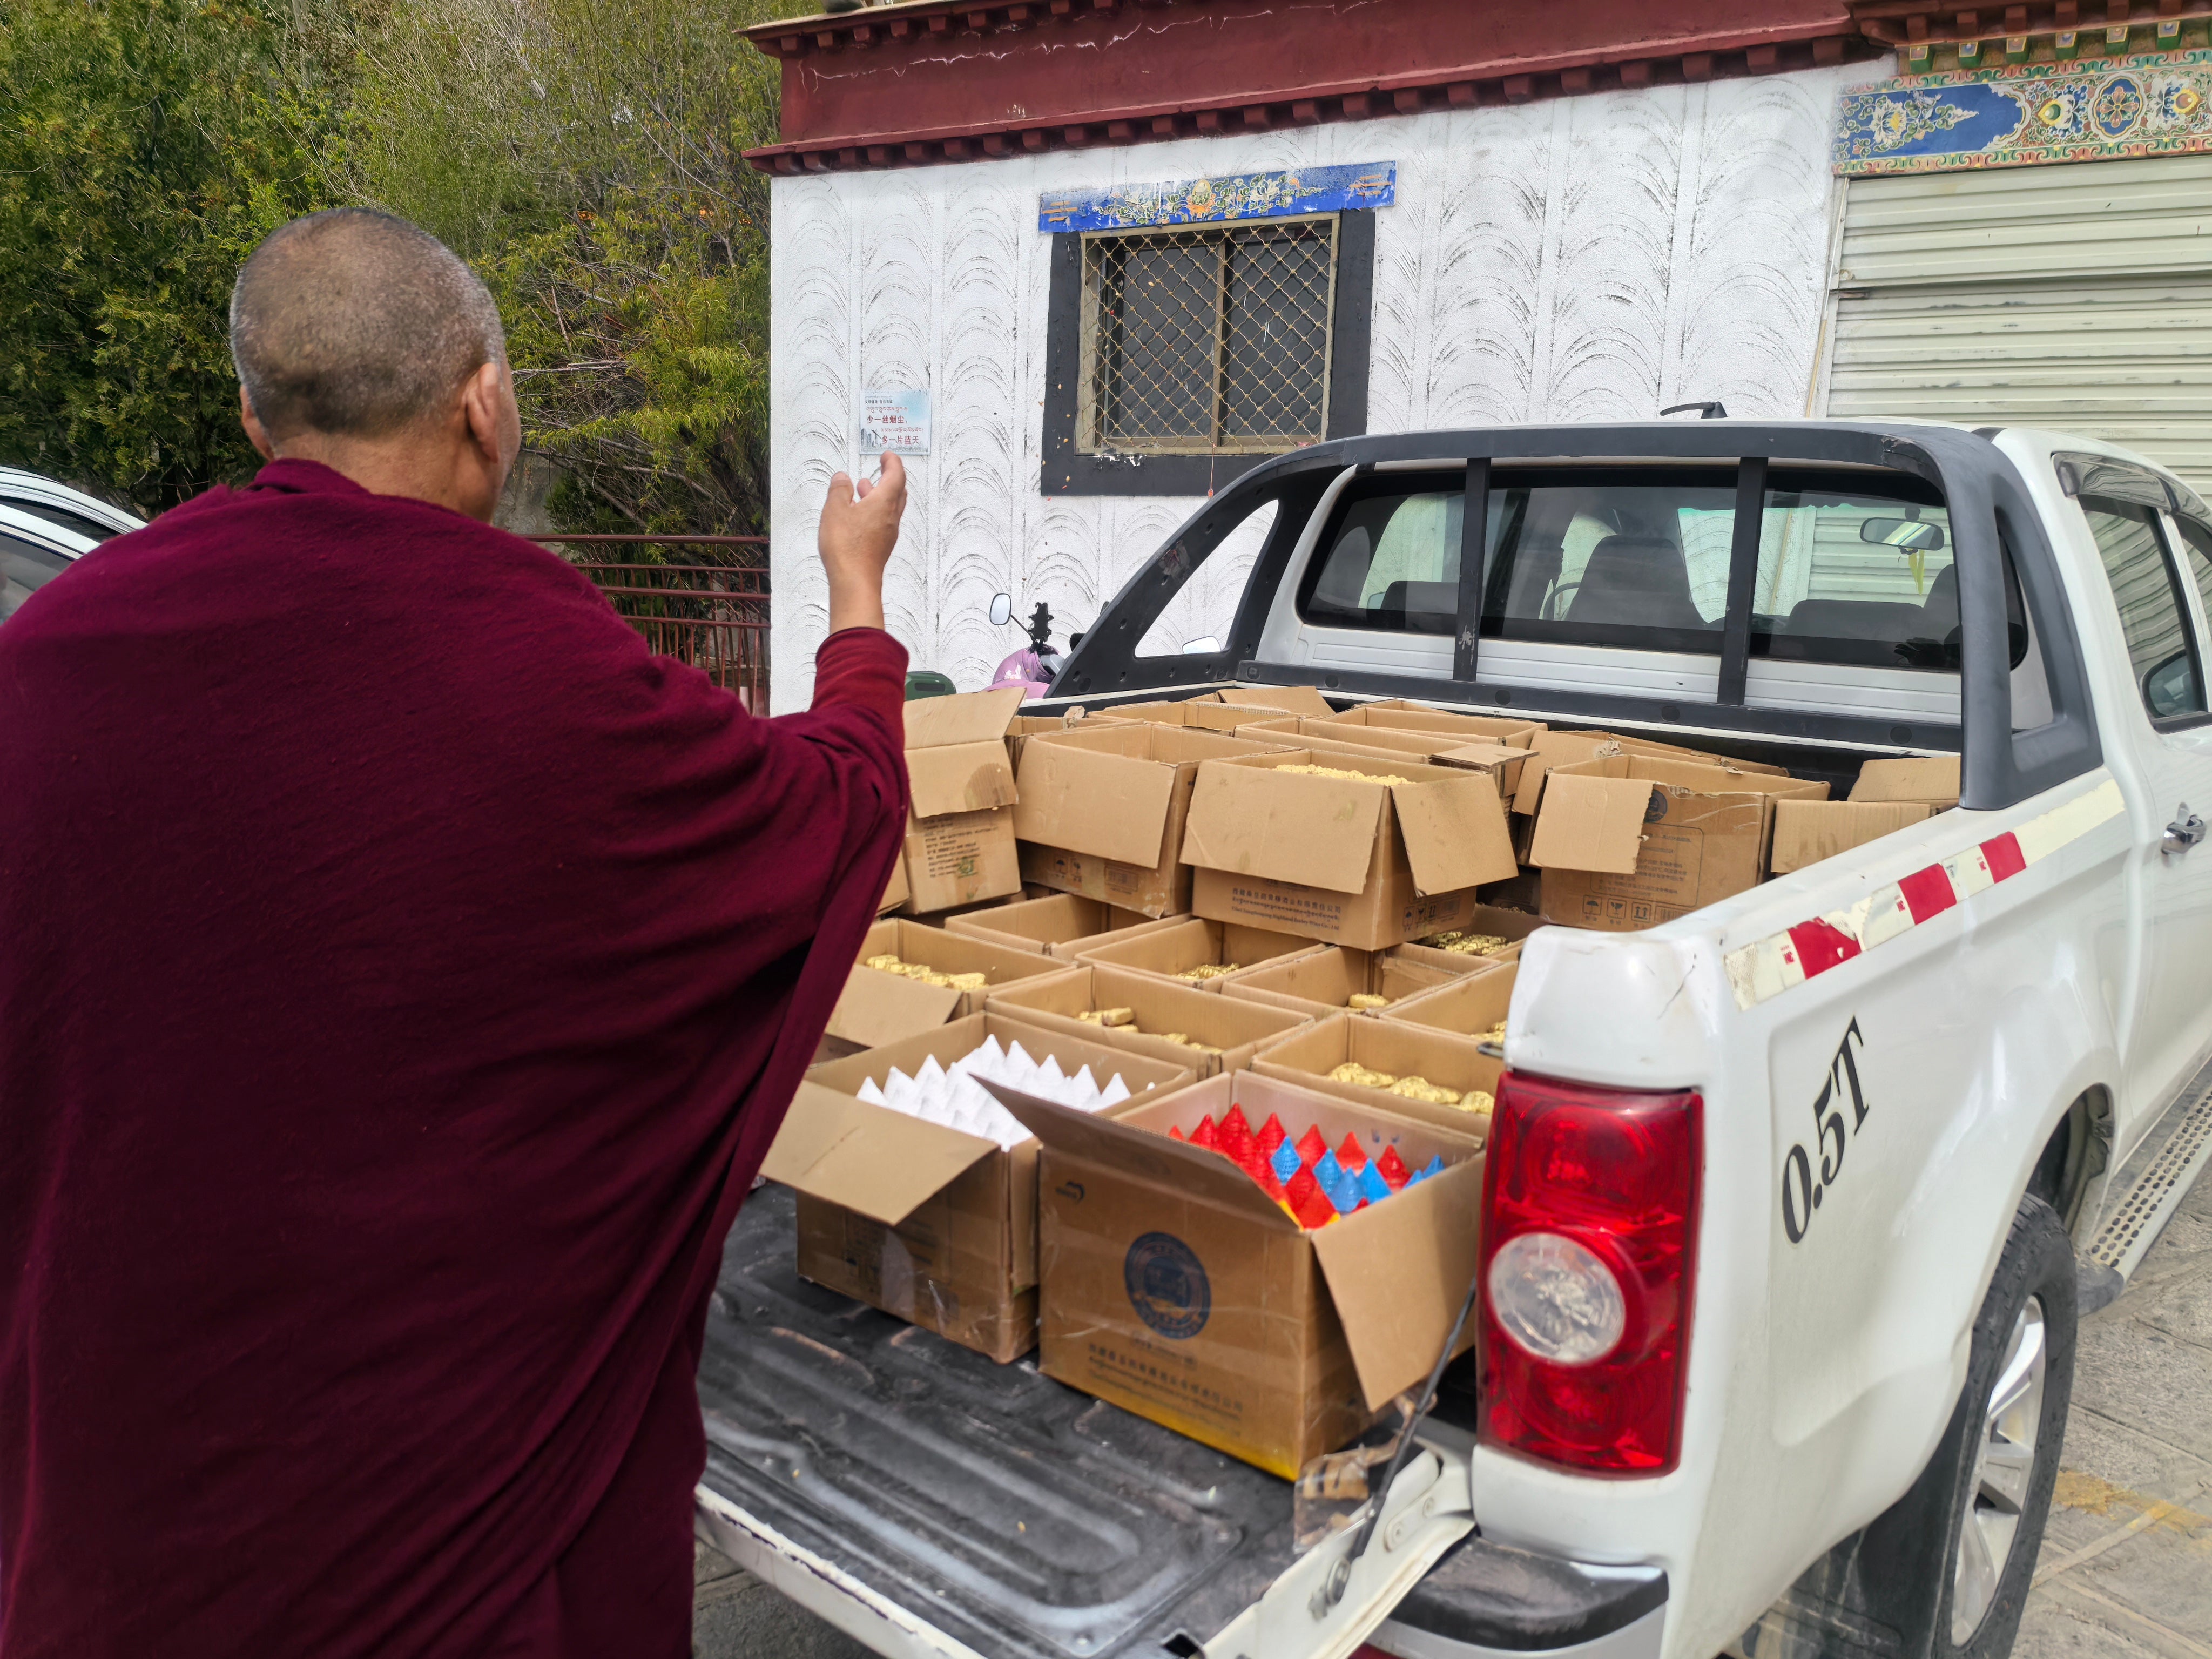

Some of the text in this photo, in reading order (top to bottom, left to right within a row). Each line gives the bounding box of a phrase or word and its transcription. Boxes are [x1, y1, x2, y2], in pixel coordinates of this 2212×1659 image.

[882, 435, 919, 444] 多一片蓝天
[1782, 1016, 1869, 1244] 0.5T
